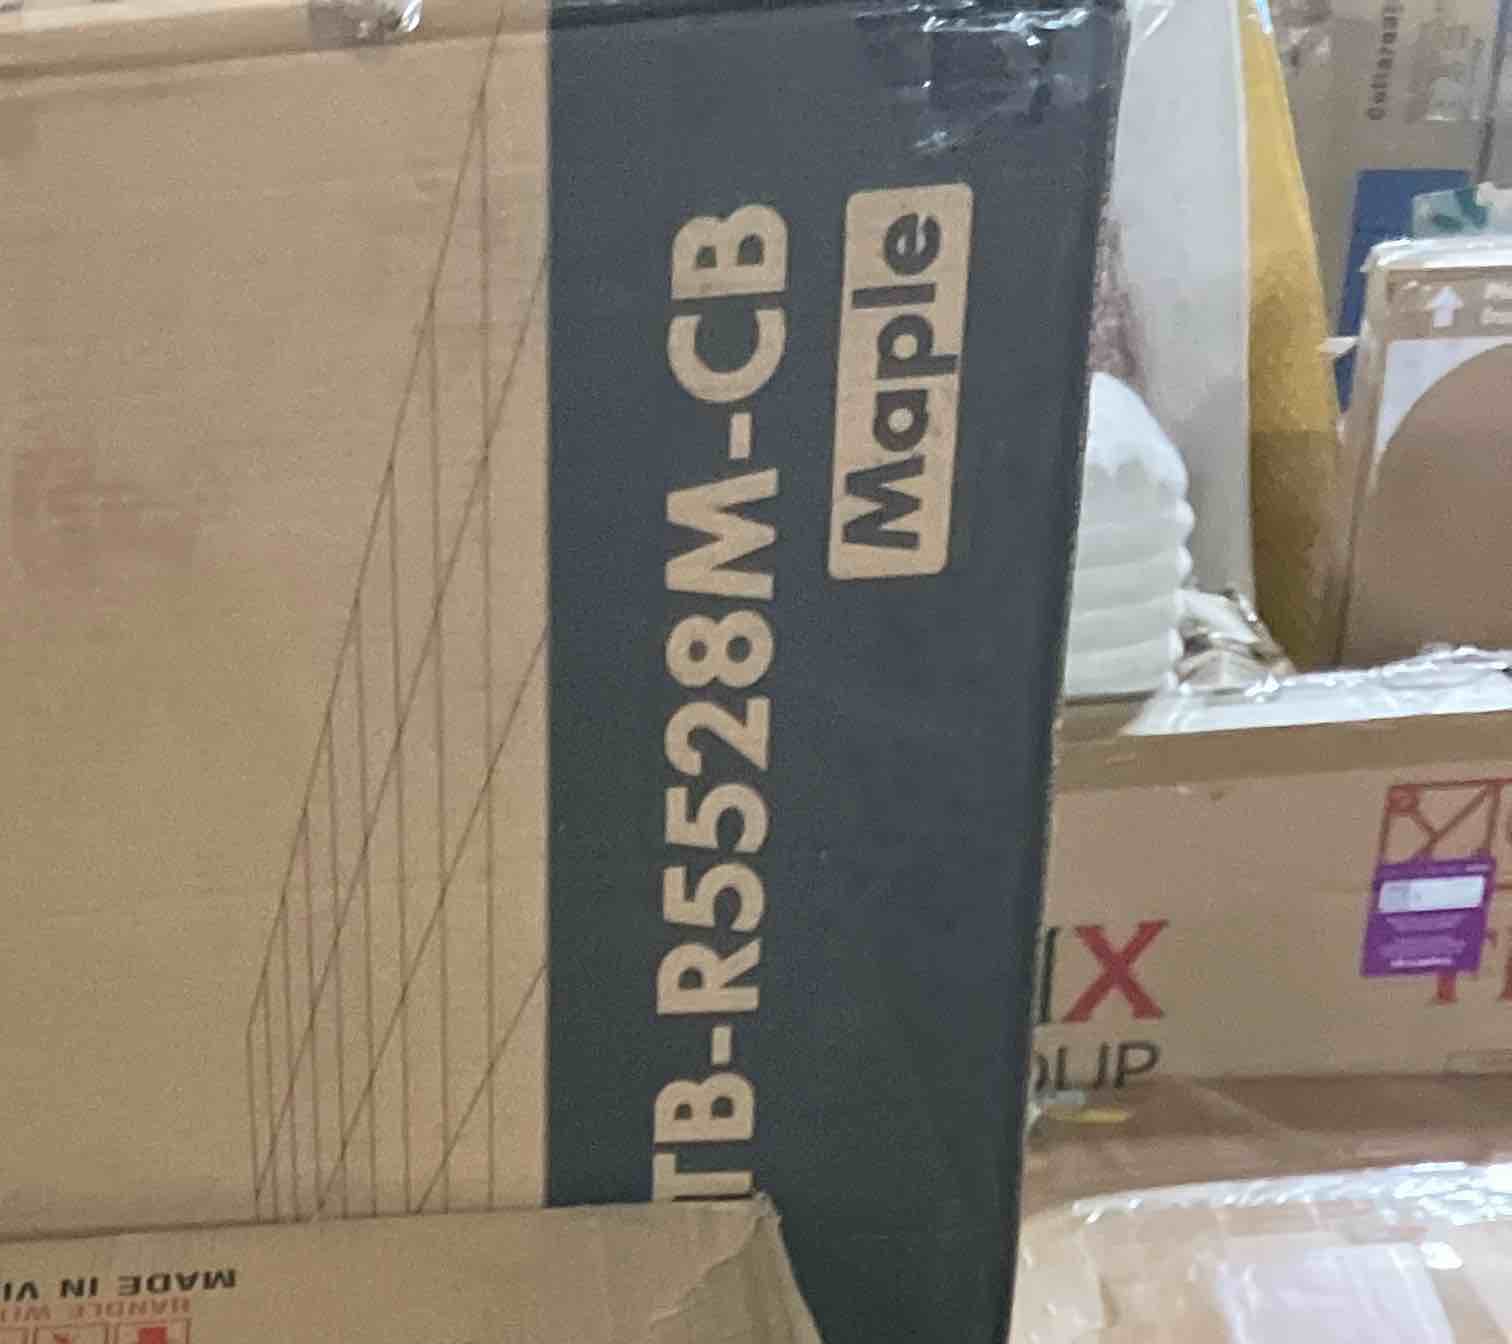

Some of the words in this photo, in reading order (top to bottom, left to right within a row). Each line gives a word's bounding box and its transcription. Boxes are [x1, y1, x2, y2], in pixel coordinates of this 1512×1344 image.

[842, 212, 960, 552] Maple
[653, 204, 788, 1202] TB-R5528M-CB
[58, 1274, 98, 1298] IN
[117, 1268, 236, 1295] MADE
[70, 1295, 190, 1320] HANDLE
